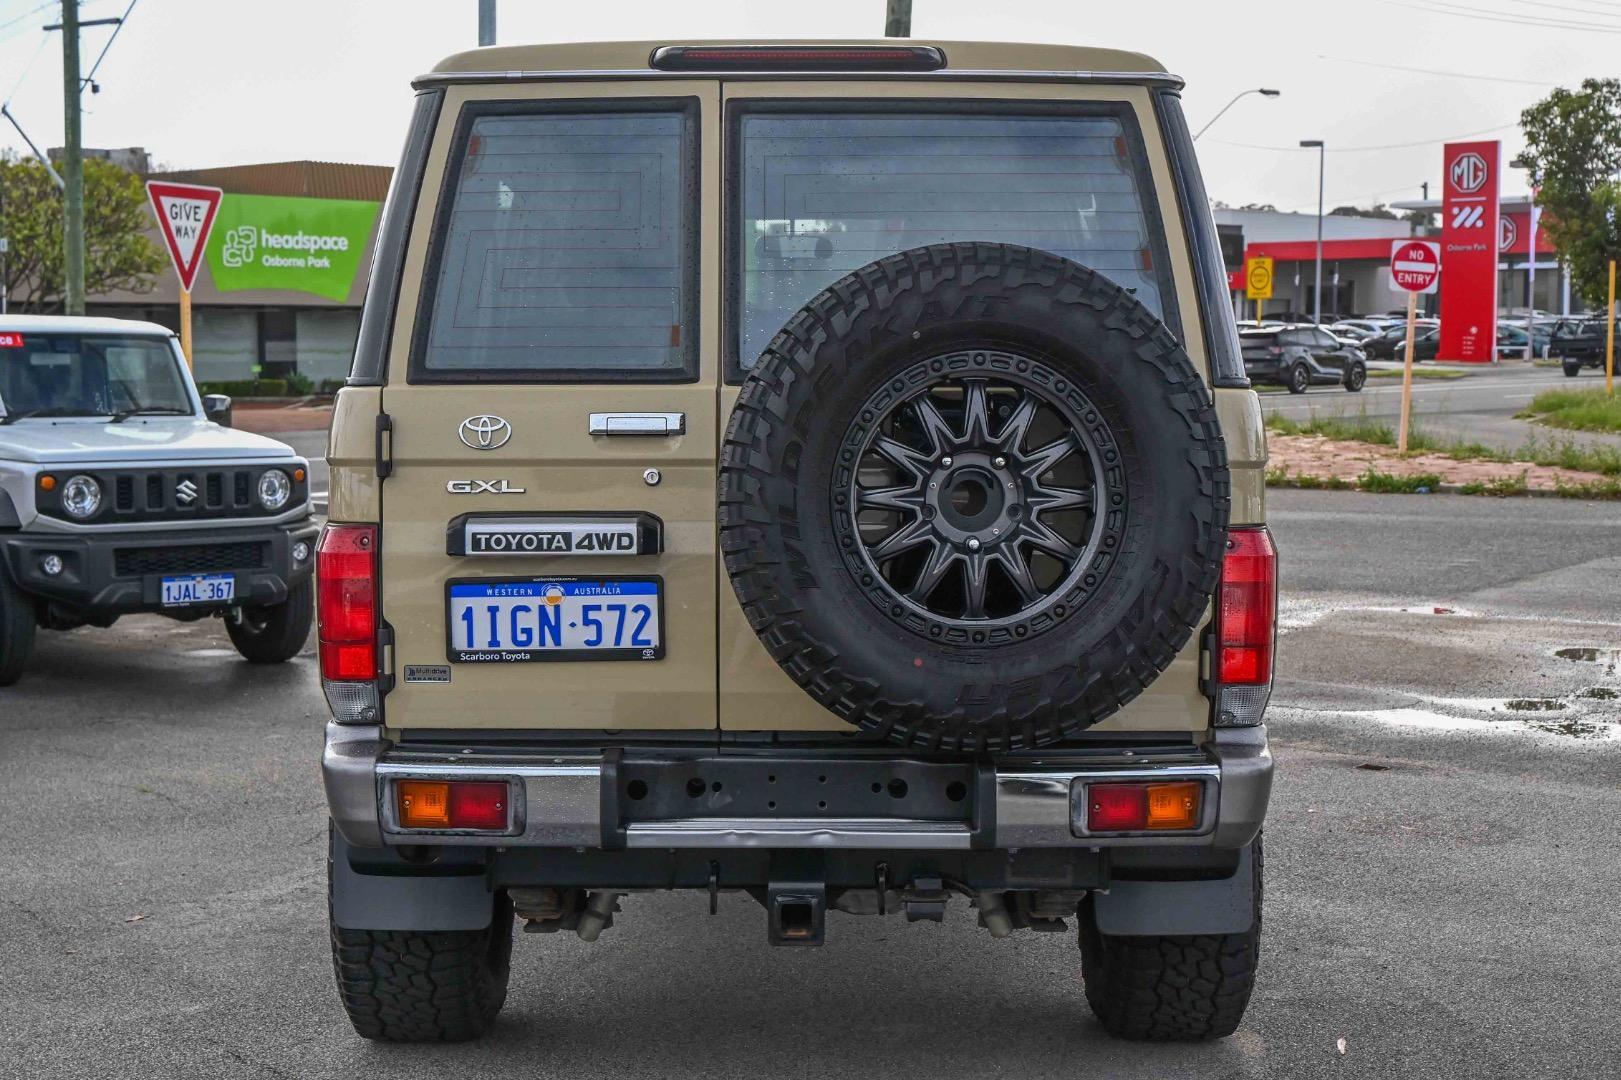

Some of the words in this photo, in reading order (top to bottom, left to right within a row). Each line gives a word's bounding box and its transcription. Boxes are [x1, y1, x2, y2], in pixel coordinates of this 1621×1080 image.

[1453, 154, 1485, 190] MG
[170, 203, 201, 222] GIVE
[175, 226, 197, 238] WAY
[261, 228, 348, 254] headspace
[262, 255, 305, 267] Osborne
[307, 256, 331, 268] Park
[1409, 249, 1425, 261] NO
[1398, 272, 1432, 285] ENTRY
[446, 479, 526, 494] GXL
[476, 534, 567, 550] TOYOTA
[575, 532, 634, 551] 4WD
[486, 588, 533, 596] WESTERN
[574, 587, 621, 595] AUSTRALIA
[460, 652, 500, 661] Scarboro
[501, 652, 531, 662] Toyota
